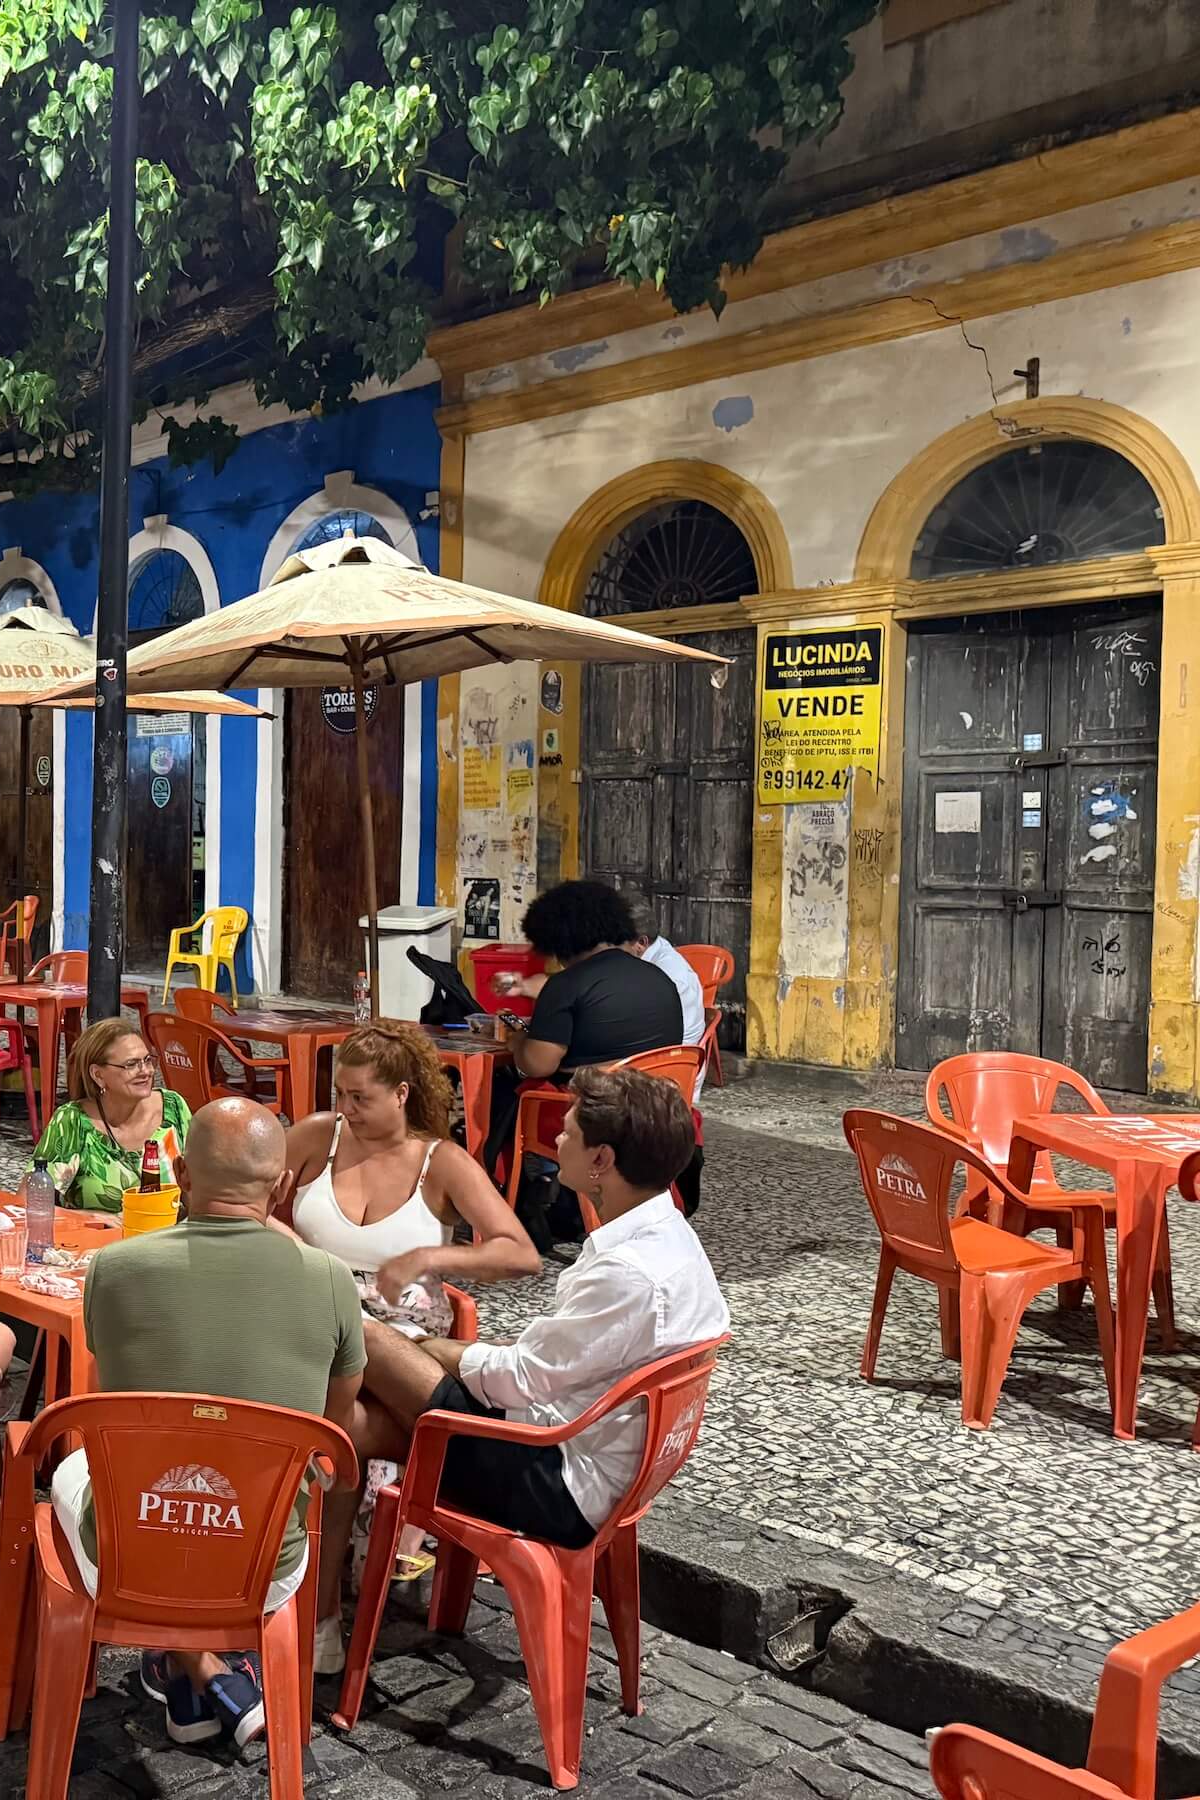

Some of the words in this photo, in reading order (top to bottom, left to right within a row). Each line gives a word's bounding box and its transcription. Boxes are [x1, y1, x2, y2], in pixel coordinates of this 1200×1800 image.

[773, 641, 872, 666] LUCINDA
[324, 691, 373, 706] TORRS
[778, 695, 864, 717] VENDE
[803, 729, 841, 737] ATENDIDA
[843, 728, 861, 736] PELA
[812, 738, 851, 746] RECENTRO
[805, 748, 815, 756] DE
[838, 748, 850, 756] ISS
[859, 748, 874, 756] ITBI
[774, 768, 871, 790] 99142-47
[164, 1051, 193, 1068] PETRA
[876, 1168, 927, 1199] PETRA
[138, 1492, 245, 1530] PETRA
